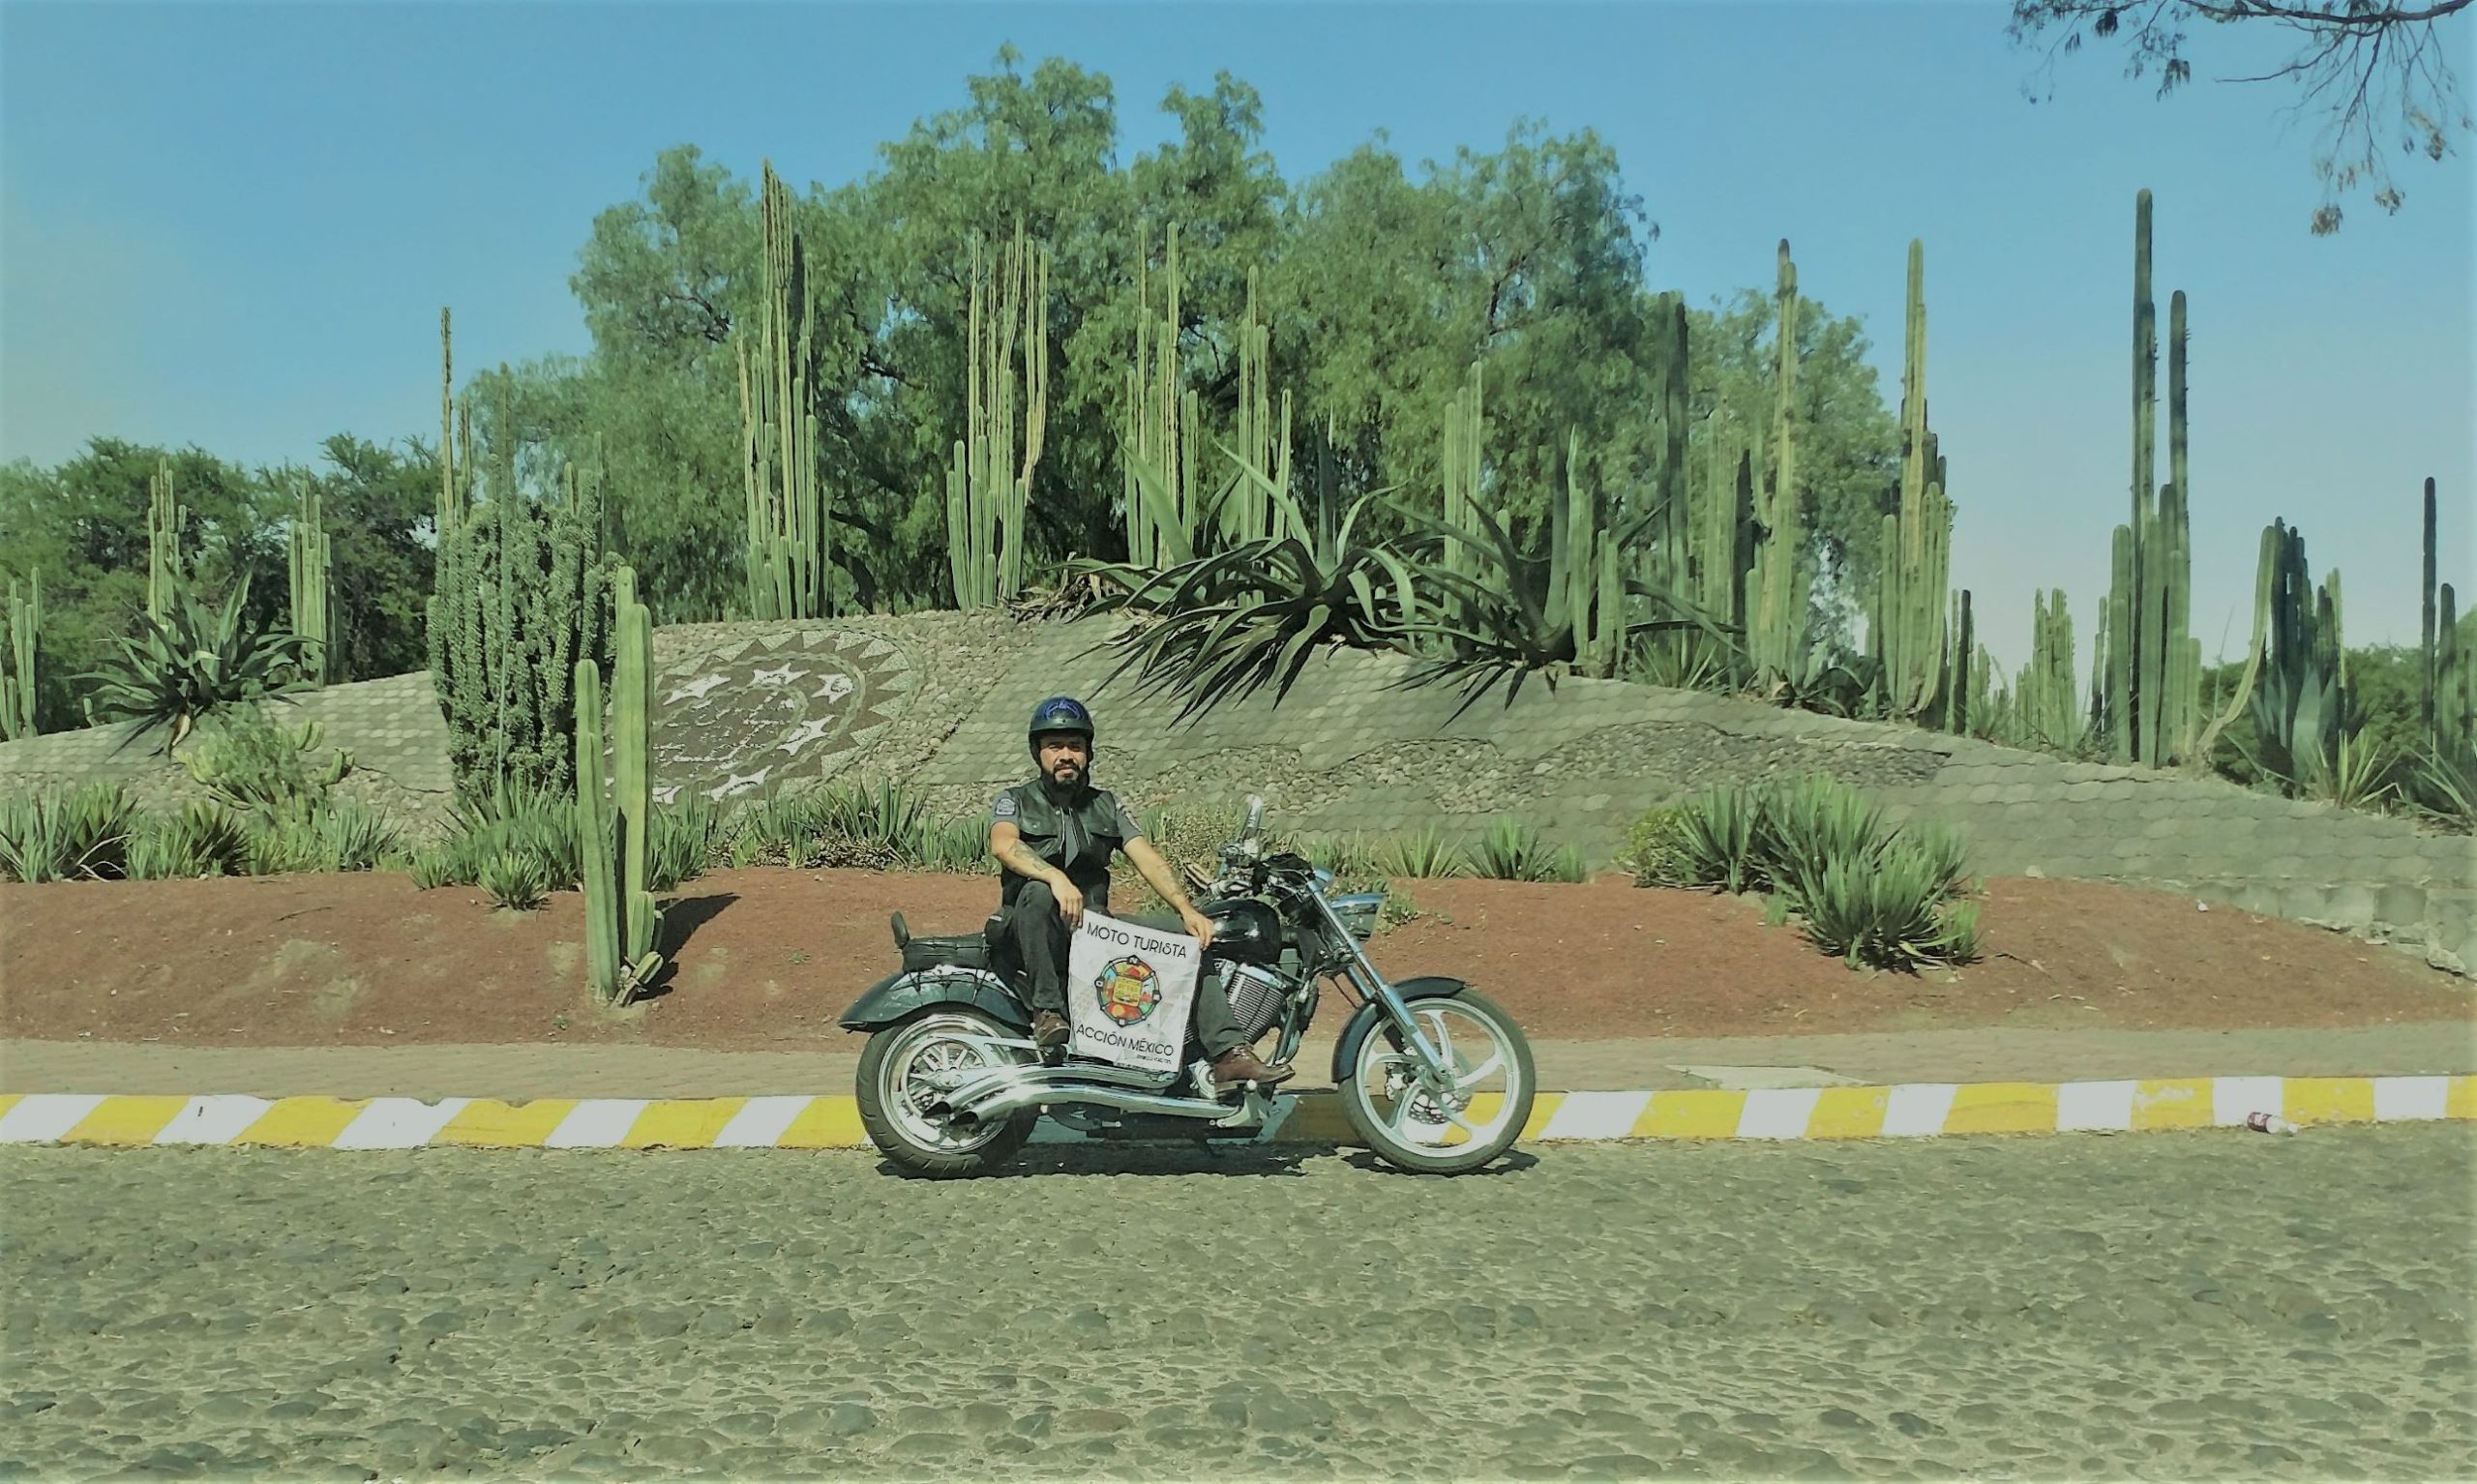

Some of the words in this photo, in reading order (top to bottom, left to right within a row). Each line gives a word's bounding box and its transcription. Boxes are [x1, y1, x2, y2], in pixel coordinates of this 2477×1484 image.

[1088, 922, 1129, 945] MOTO
[1134, 935, 1186, 958] TURISTA
[1076, 1024, 1127, 1048] ACCIÓN
[1128, 1038, 1174, 1056] MÉXICO
